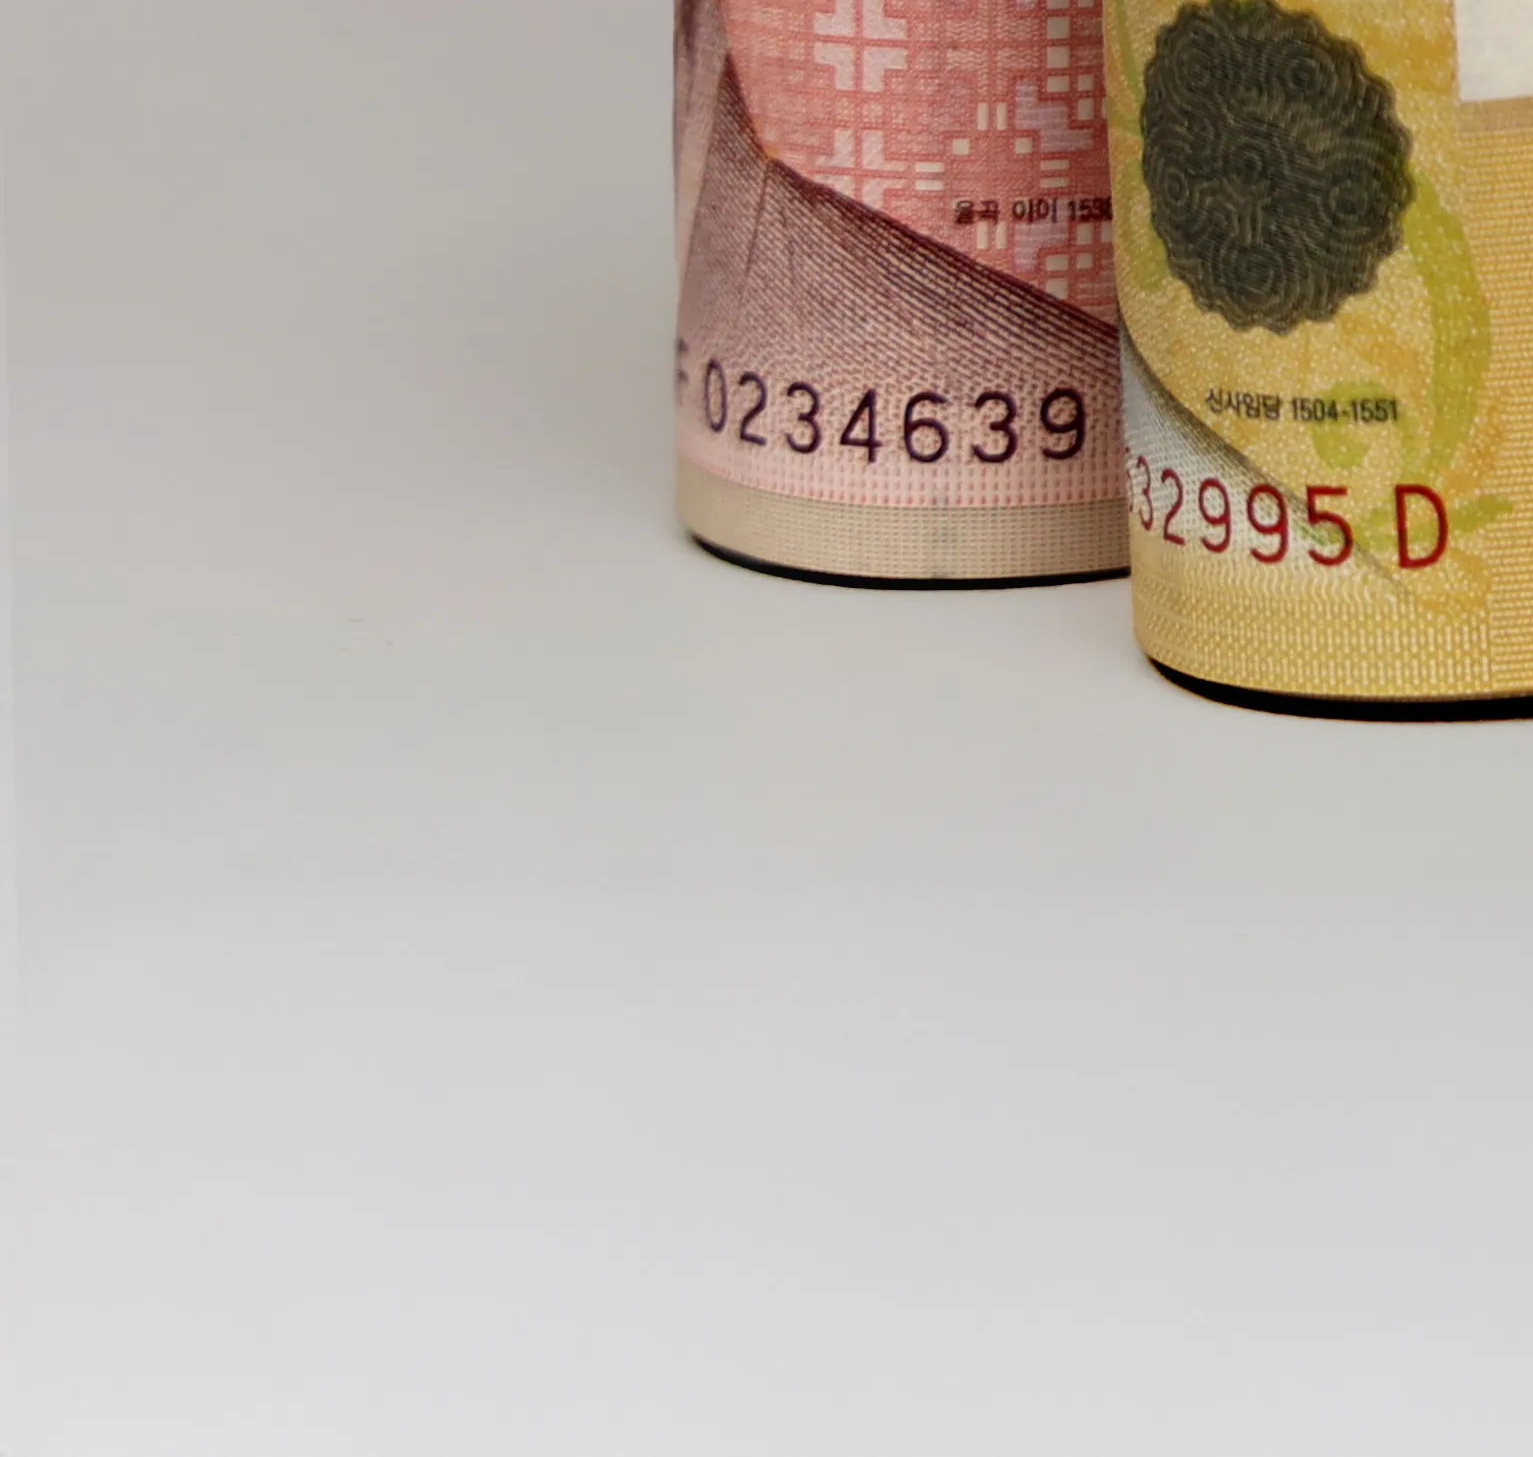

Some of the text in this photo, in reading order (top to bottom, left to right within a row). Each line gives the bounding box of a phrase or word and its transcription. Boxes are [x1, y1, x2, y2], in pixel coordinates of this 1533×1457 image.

[1206, 387, 1400, 423] 신사임당 1504-1551
[1394, 483, 1449, 570] D
